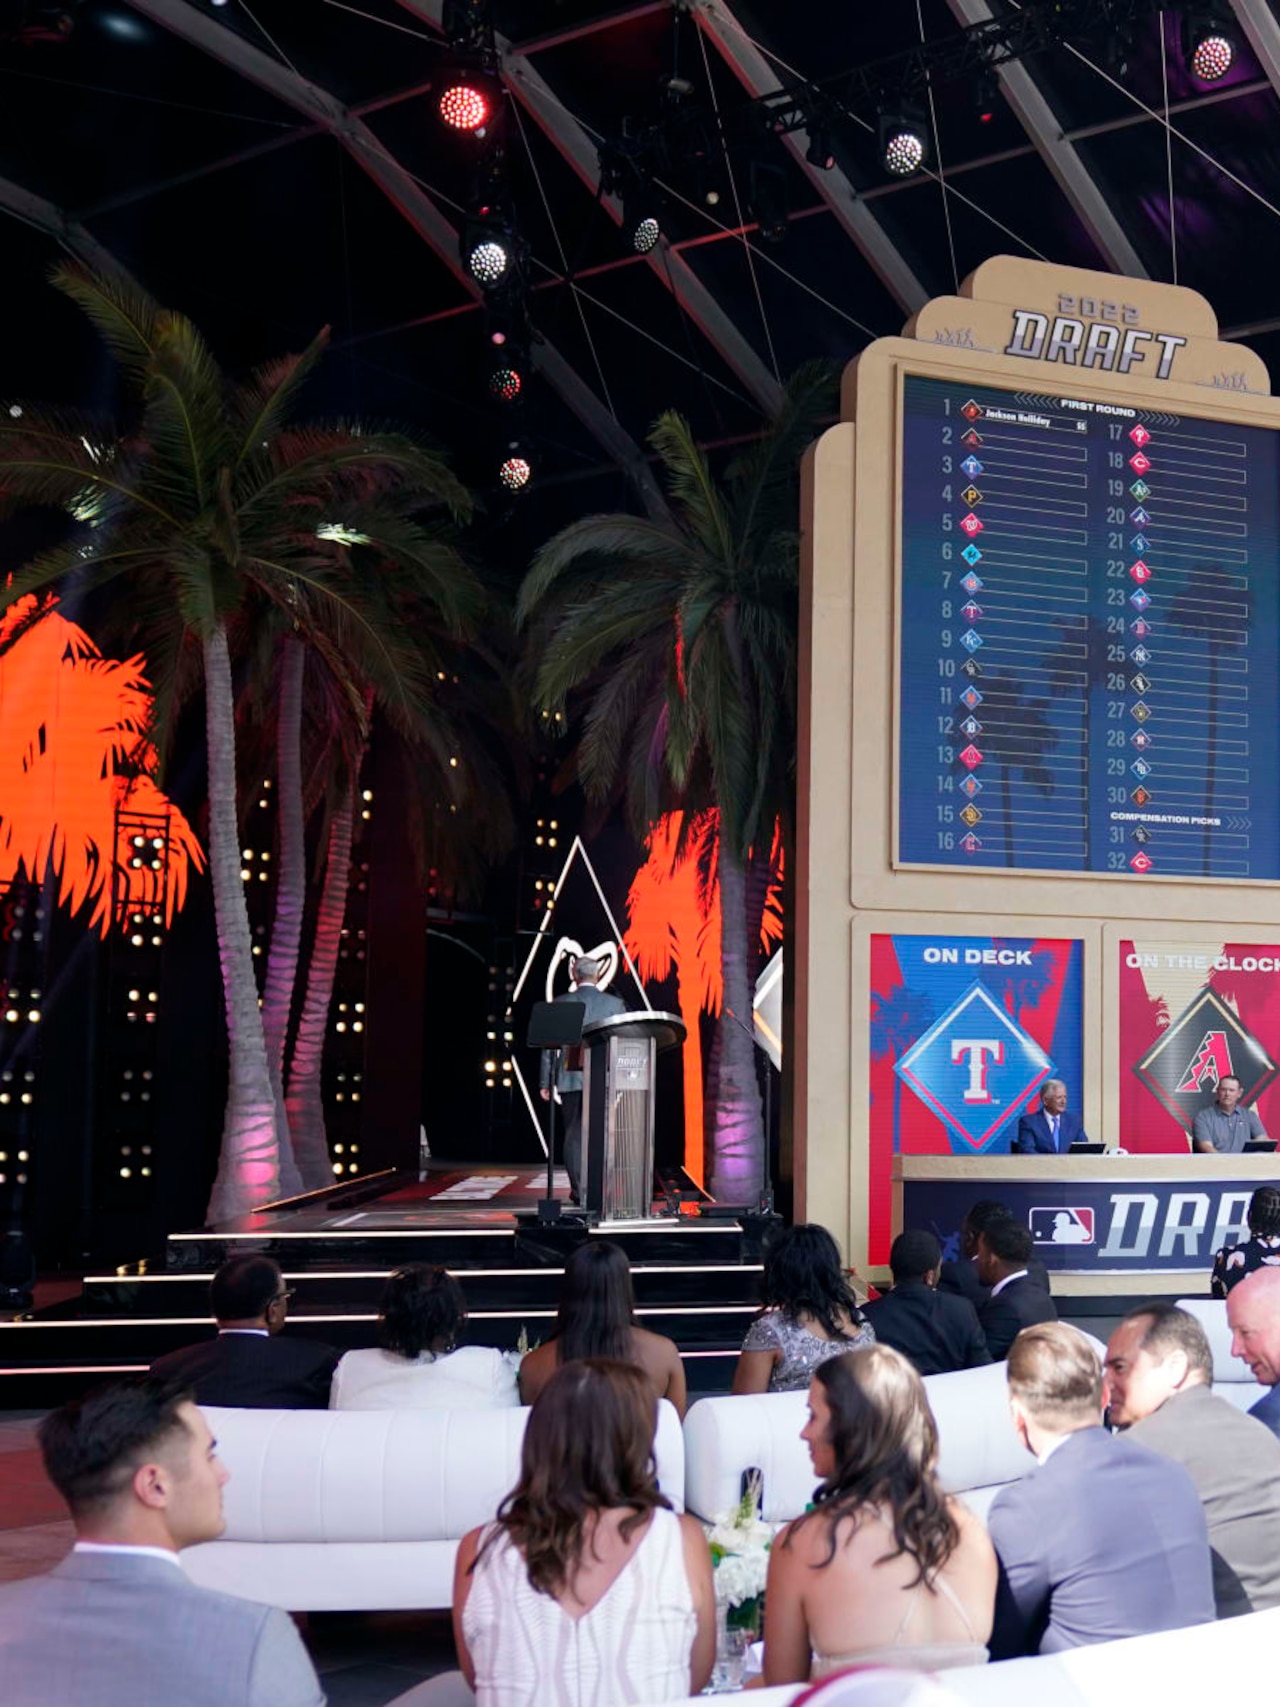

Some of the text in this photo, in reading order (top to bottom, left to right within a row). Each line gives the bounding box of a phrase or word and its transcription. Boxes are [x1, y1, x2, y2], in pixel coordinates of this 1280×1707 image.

[1058, 294, 1141, 325] 2022
[1004, 310, 1187, 379] DRAFT
[943, 398, 950, 416] 1
[985, 408, 1017, 421] Jackson
[1060, 398, 1136, 418] FIRST ROUND
[942, 426, 953, 445] 2
[1108, 423, 1123, 441] 17
[942, 455, 953, 474] 3
[1107, 451, 1146, 469] 18 C
[942, 484, 977, 504] 4 P
[1107, 479, 1124, 497] 19
[942, 513, 953, 531] 5
[1106, 506, 1126, 525] 20
[1108, 532, 1124, 550] 21
[942, 542, 953, 560] 6
[1106, 560, 1125, 578] 22
[942, 571, 953, 589] 7
[1106, 588, 1126, 606] 23
[942, 601, 952, 618] 8
[1106, 615, 1125, 634] 24
[942, 629, 952, 648] 9
[1107, 644, 1126, 662] 25
[938, 659, 955, 677] 10
[1106, 672, 1126, 691] 26
[939, 686, 953, 705] 11
[1107, 700, 1126, 719] 27
[938, 716, 954, 734] 12
[1106, 729, 1126, 748] 28
[937, 745, 954, 763] 13
[1107, 758, 1126, 776] 29
[937, 775, 954, 793] 14
[1107, 786, 1127, 804] 30
[937, 805, 954, 822] 15
[1110, 811, 1221, 827] COMPENSATION PICKS
[937, 832, 954, 850] 16
[1109, 826, 1125, 843] 31
[1107, 851, 1126, 869] 32
[923, 947, 1033, 966] ON DECK
[1125, 953, 1162, 970] ON
[1163, 954, 1209, 971] THE
[952, 1038, 1004, 1105] T
